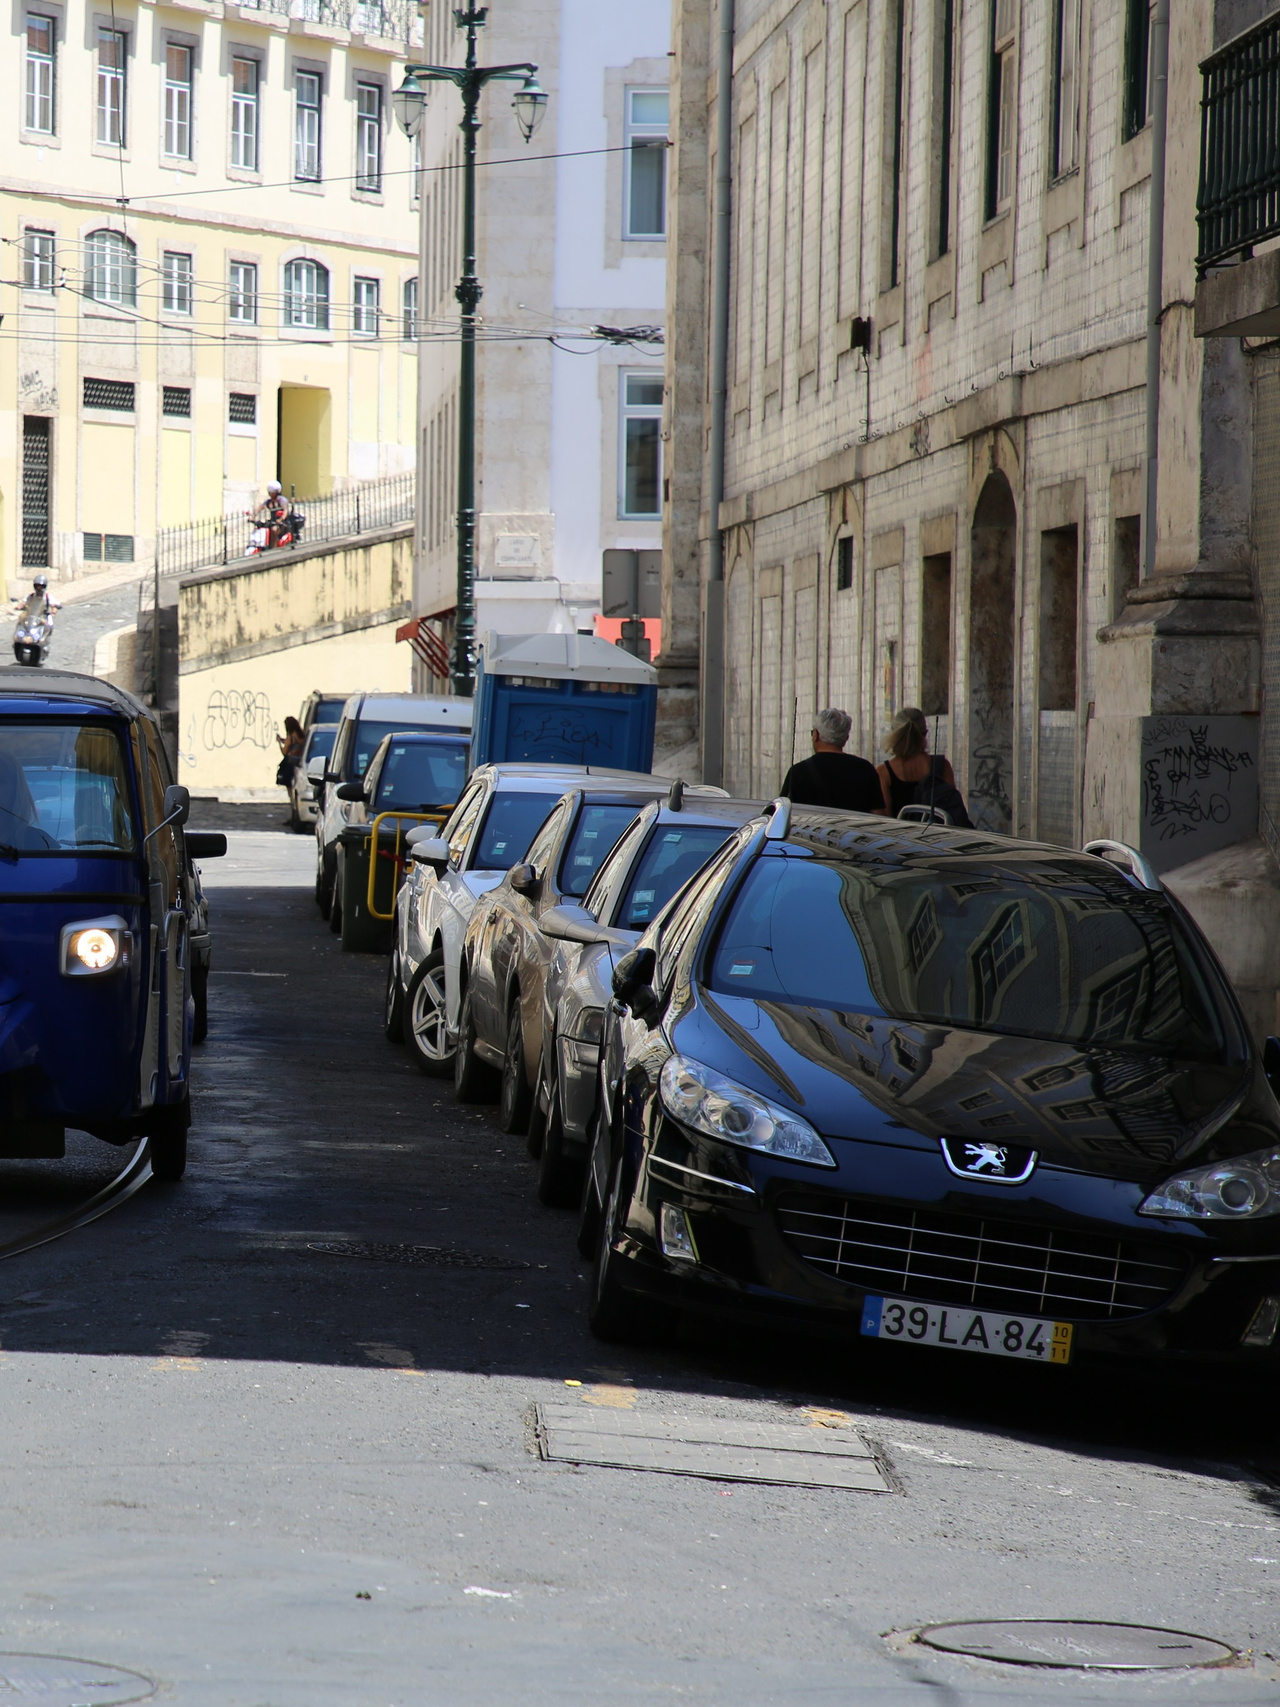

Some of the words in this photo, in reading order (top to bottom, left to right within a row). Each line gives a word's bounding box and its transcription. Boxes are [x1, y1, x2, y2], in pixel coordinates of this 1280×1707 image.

[866, 1319, 875, 1329] P
[1053, 1325, 1069, 1339] 10
[1051, 1346, 1067, 1360] 11
